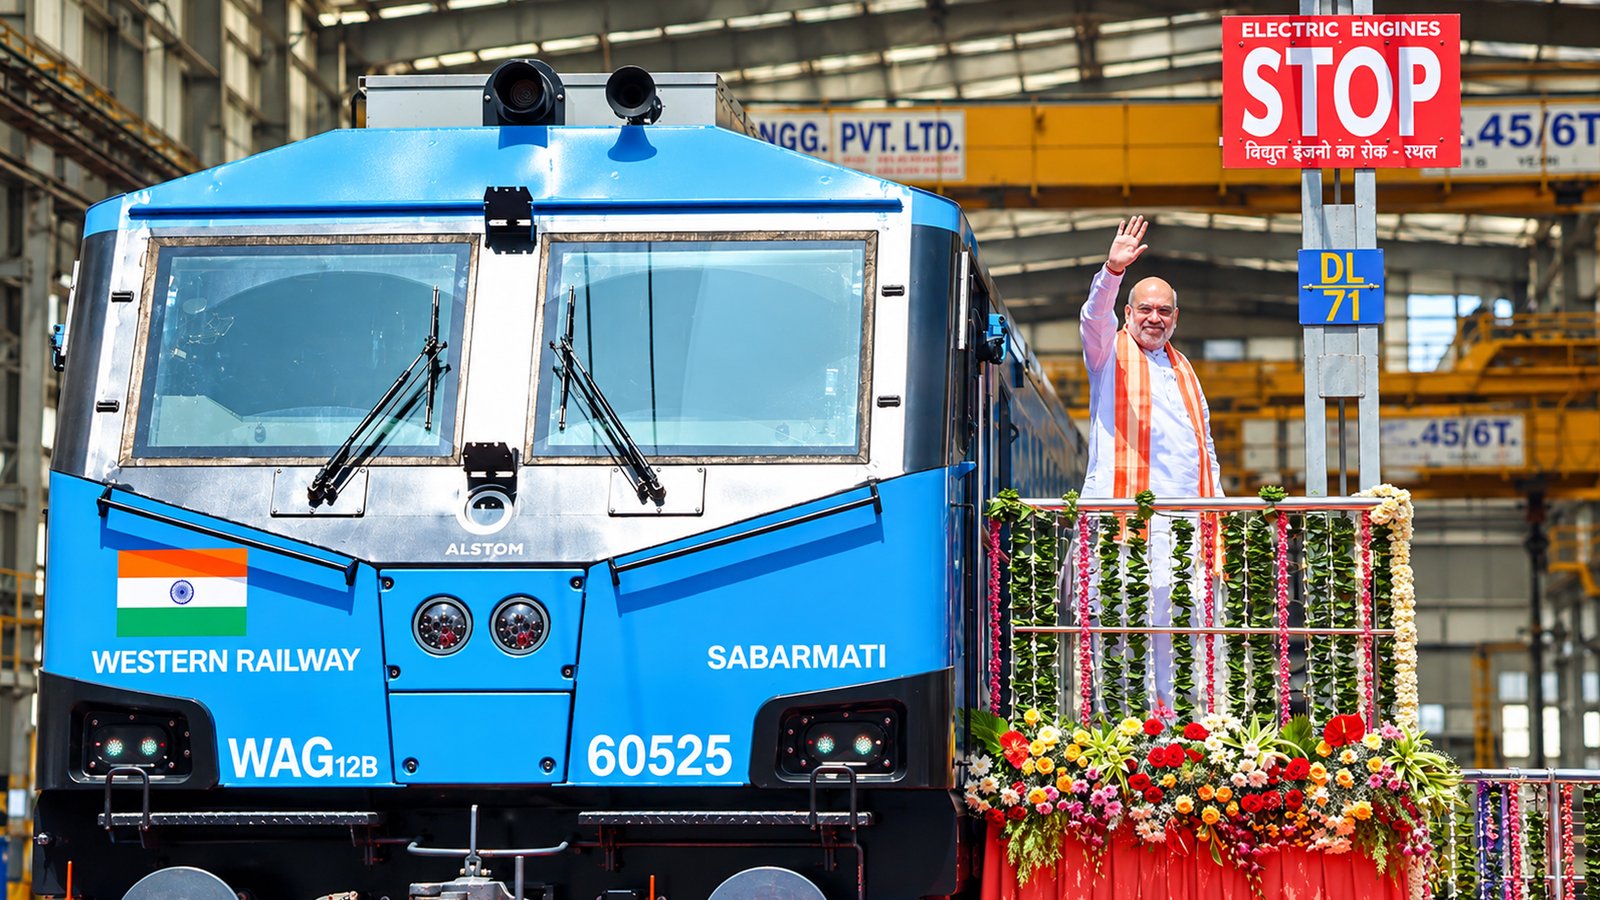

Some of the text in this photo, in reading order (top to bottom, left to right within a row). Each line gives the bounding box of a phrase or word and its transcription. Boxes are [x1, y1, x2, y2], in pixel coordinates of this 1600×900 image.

[1241, 20, 1441, 38] ELECTRIC ENGINES
[1241, 46, 1442, 138] STOP
[841, 121, 896, 152] PVT.
[904, 121, 960, 152] LTD.
[1245, 140, 1288, 165] विद्युत
[1335, 144, 1355, 159] का
[1360, 139, 1389, 159] रोक
[1320, 252, 1365, 284] DL
[1322, 289, 1361, 321] 71
[445, 542, 524, 556] ALSTOM
[91, 647, 361, 674] WESTERN RAILWAY
[707, 644, 887, 670] SABARMATI
[587, 733, 733, 777] 60525
